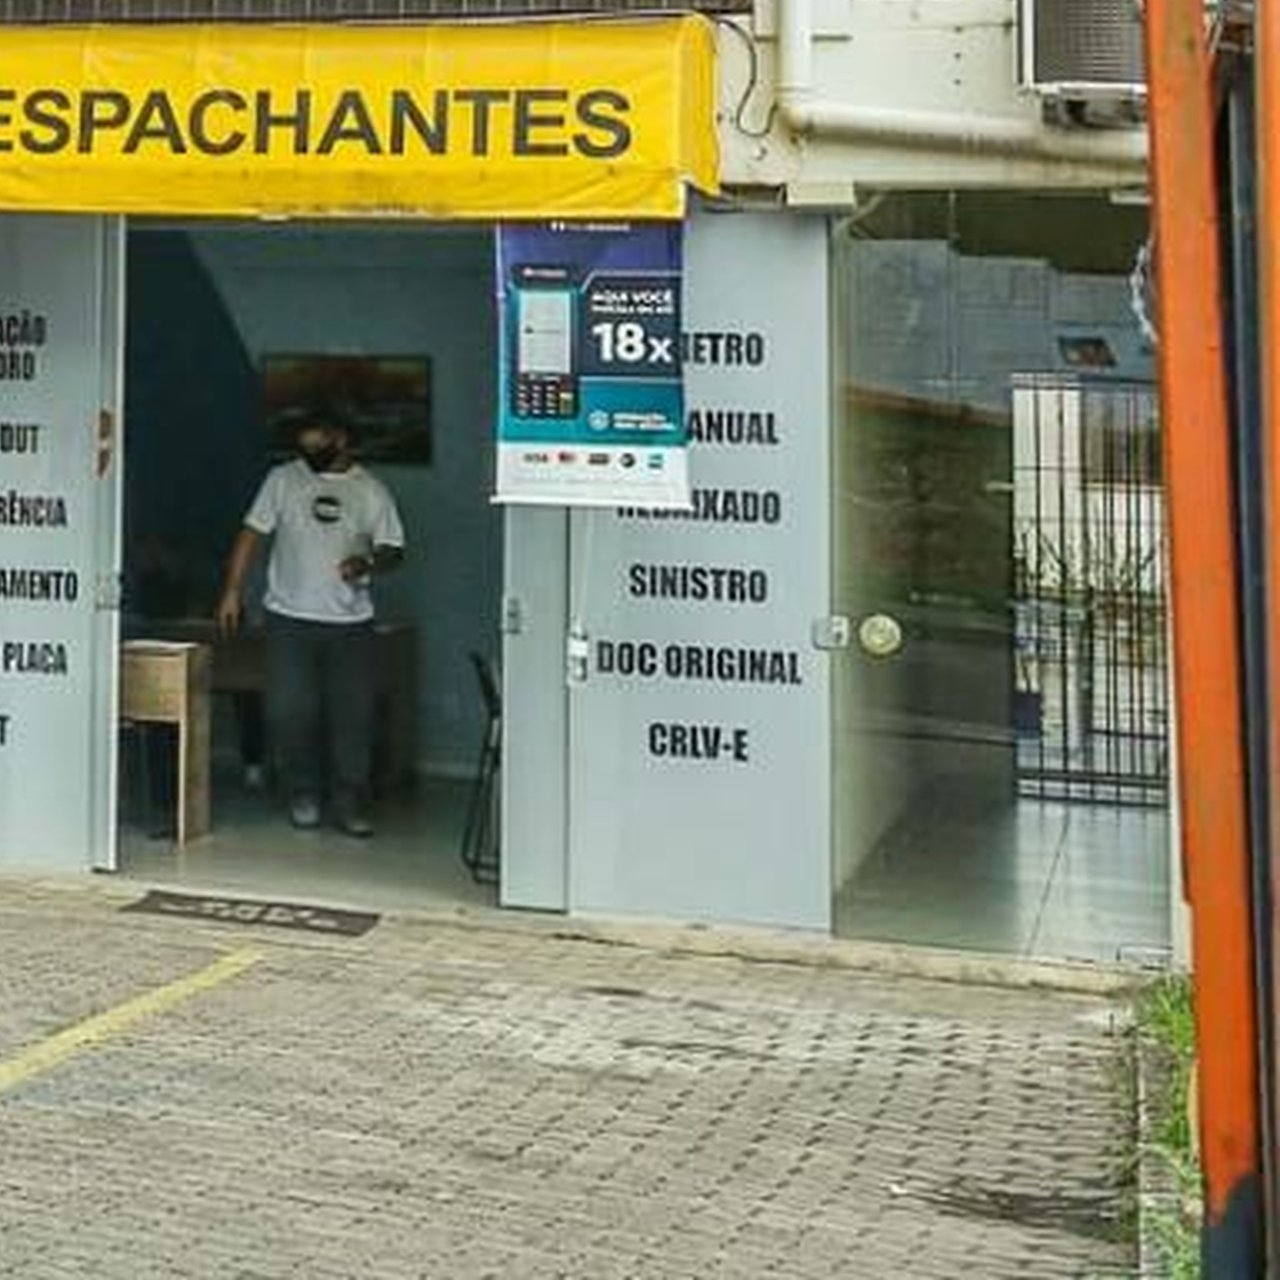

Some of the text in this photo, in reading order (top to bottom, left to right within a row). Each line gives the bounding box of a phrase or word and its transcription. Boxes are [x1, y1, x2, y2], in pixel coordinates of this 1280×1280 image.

[592, 322, 673, 363] 18x
[683, 332, 764, 367] ETRO
[0, 423, 42, 453] DUT
[617, 489, 781, 524] IXADO
[629, 563, 768, 603] SINISTRO
[3, 641, 68, 675] PLACA
[597, 640, 803, 686] DOC ORIGINAL
[648, 722, 748, 762] CRLV-E
